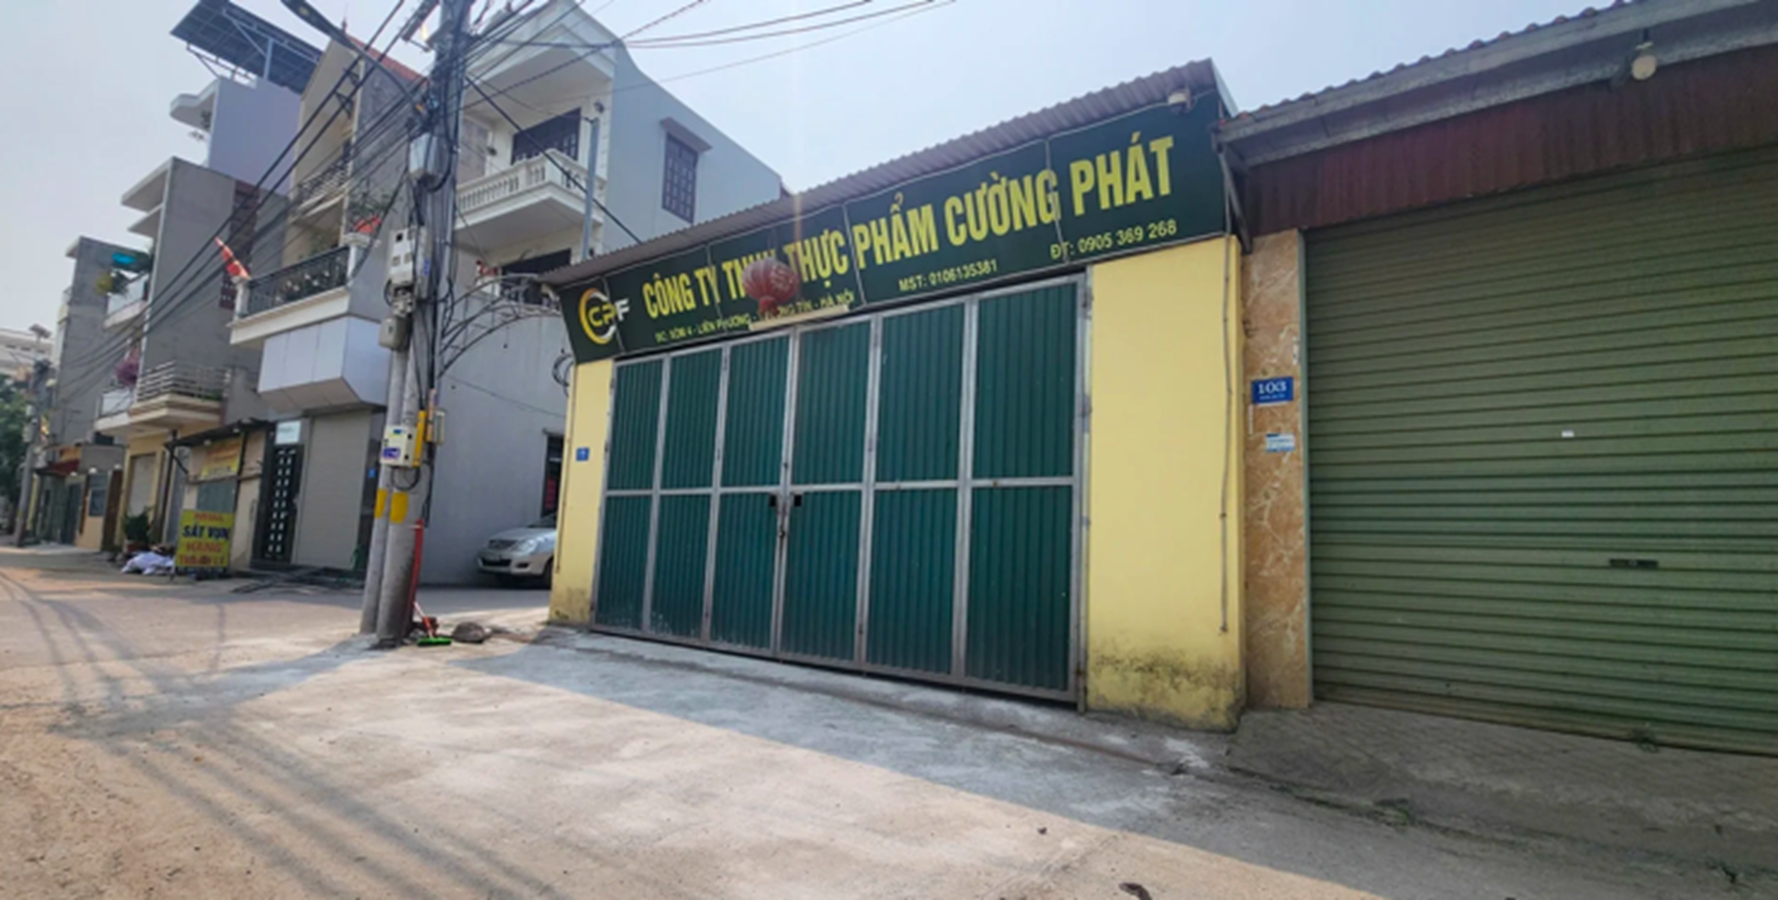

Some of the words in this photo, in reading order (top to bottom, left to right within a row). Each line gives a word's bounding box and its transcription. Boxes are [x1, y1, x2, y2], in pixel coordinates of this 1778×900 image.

[642, 272, 697, 319] CÔNG
[694, 264, 721, 306] TY
[722, 249, 777, 300] TN
[783, 229, 849, 288] THỰC
[852, 191, 939, 271] PHẨM
[944, 170, 1062, 248] CƯỜNG
[1069, 131, 1175, 217] PHÁT
[1078, 232, 1113, 254] 0905
[1115, 225, 1144, 246] 369
[1147, 218, 1177, 239] 268
[898, 273, 928, 292] MST:
[1258, 381, 1287, 395] 103
